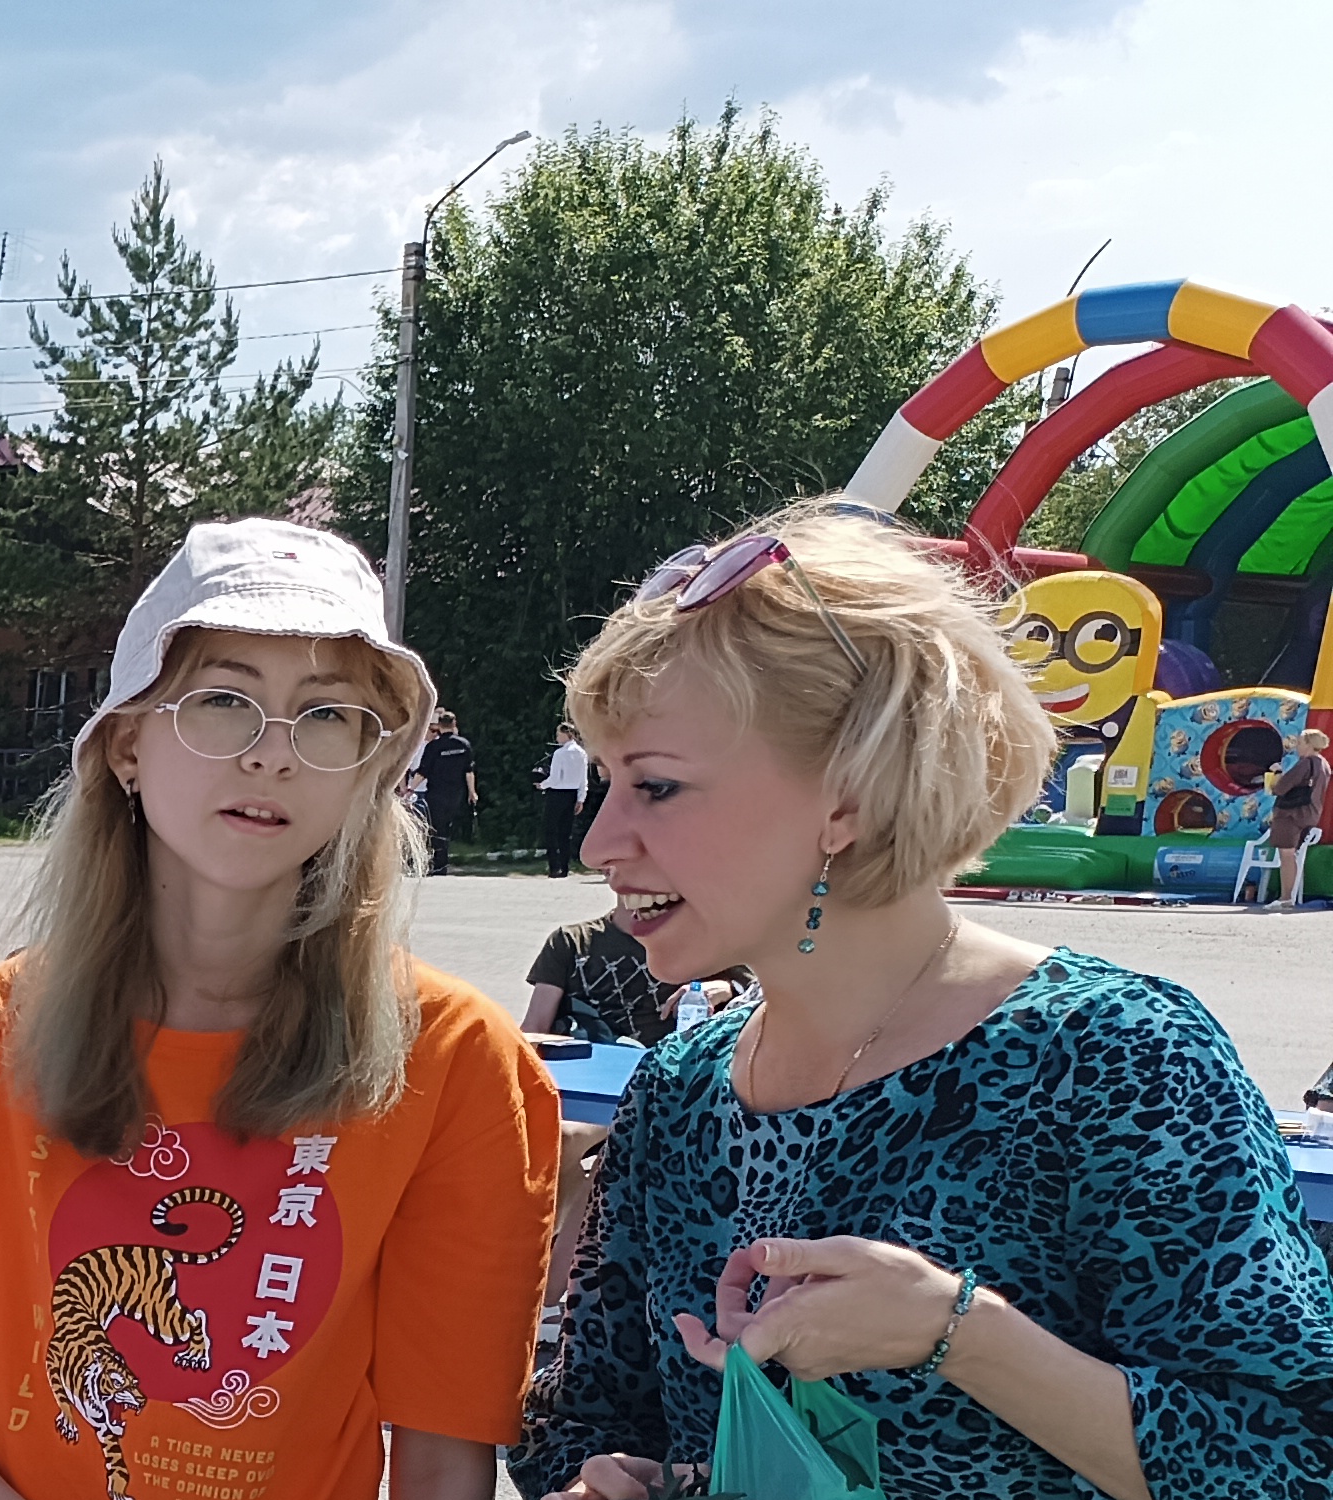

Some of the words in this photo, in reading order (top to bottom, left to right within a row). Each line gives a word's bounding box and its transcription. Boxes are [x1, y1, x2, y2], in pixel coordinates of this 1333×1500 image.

[269, 1134, 338, 1228] 東京
[241, 1253, 304, 1359] 日本
[150, 1435, 159, 1448] A
[166, 1438, 213, 1458] TIGER
[220, 1447, 275, 1464] NEVER
[134, 1451, 179, 1472] LOSES
[185, 1462, 239, 1481] SLEEP
[143, 1472, 171, 1489] THE
[176, 1480, 244, 1500] OPINION
[249, 1486, 267, 1500] OF
